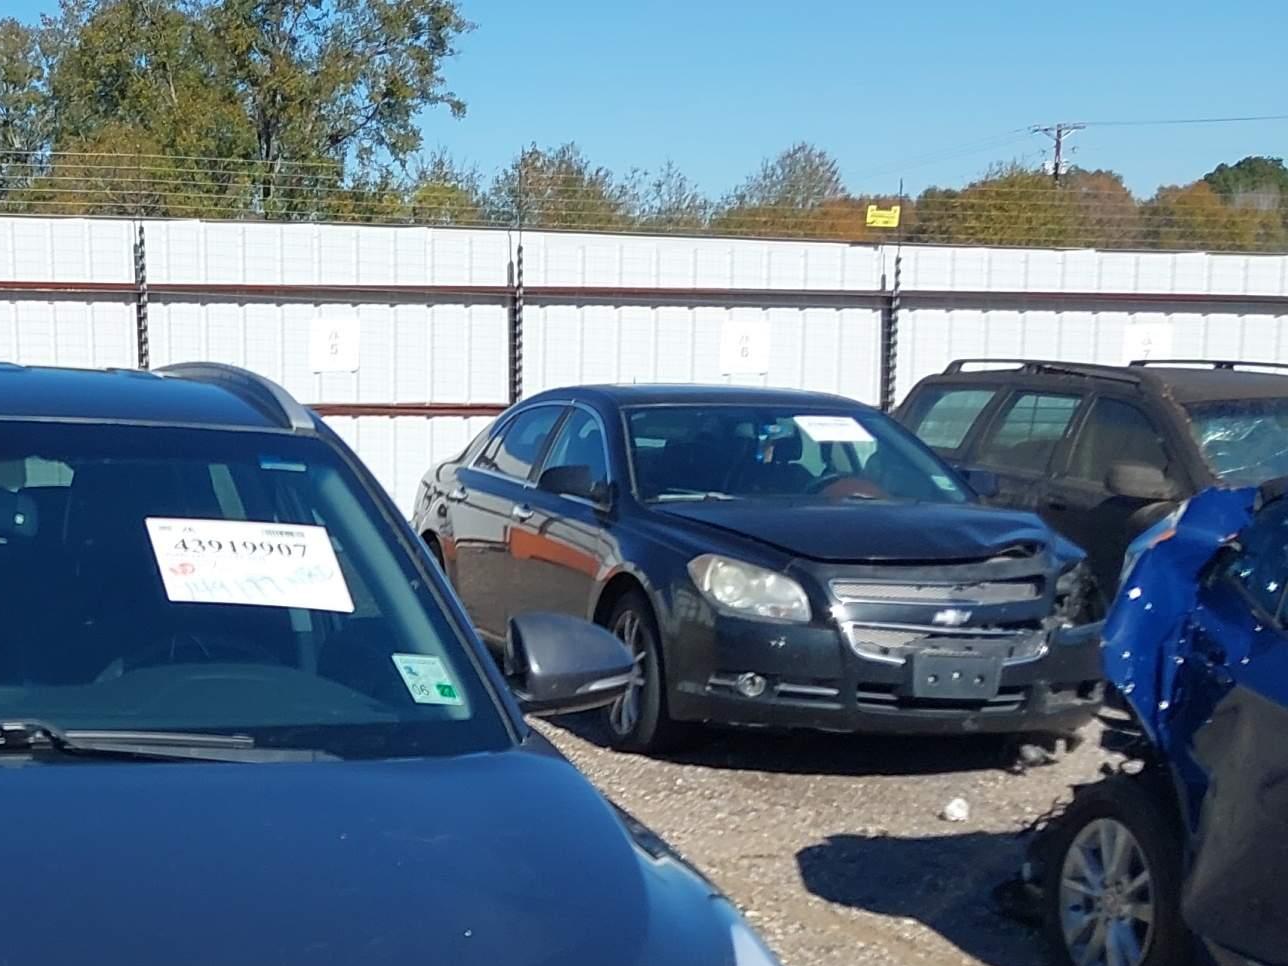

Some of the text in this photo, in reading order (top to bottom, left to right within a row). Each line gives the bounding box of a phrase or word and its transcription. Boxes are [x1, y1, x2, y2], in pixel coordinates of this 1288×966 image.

[329, 343, 339, 356] 5
[740, 346, 750, 358] 6
[174, 537, 308, 558] 43919907
